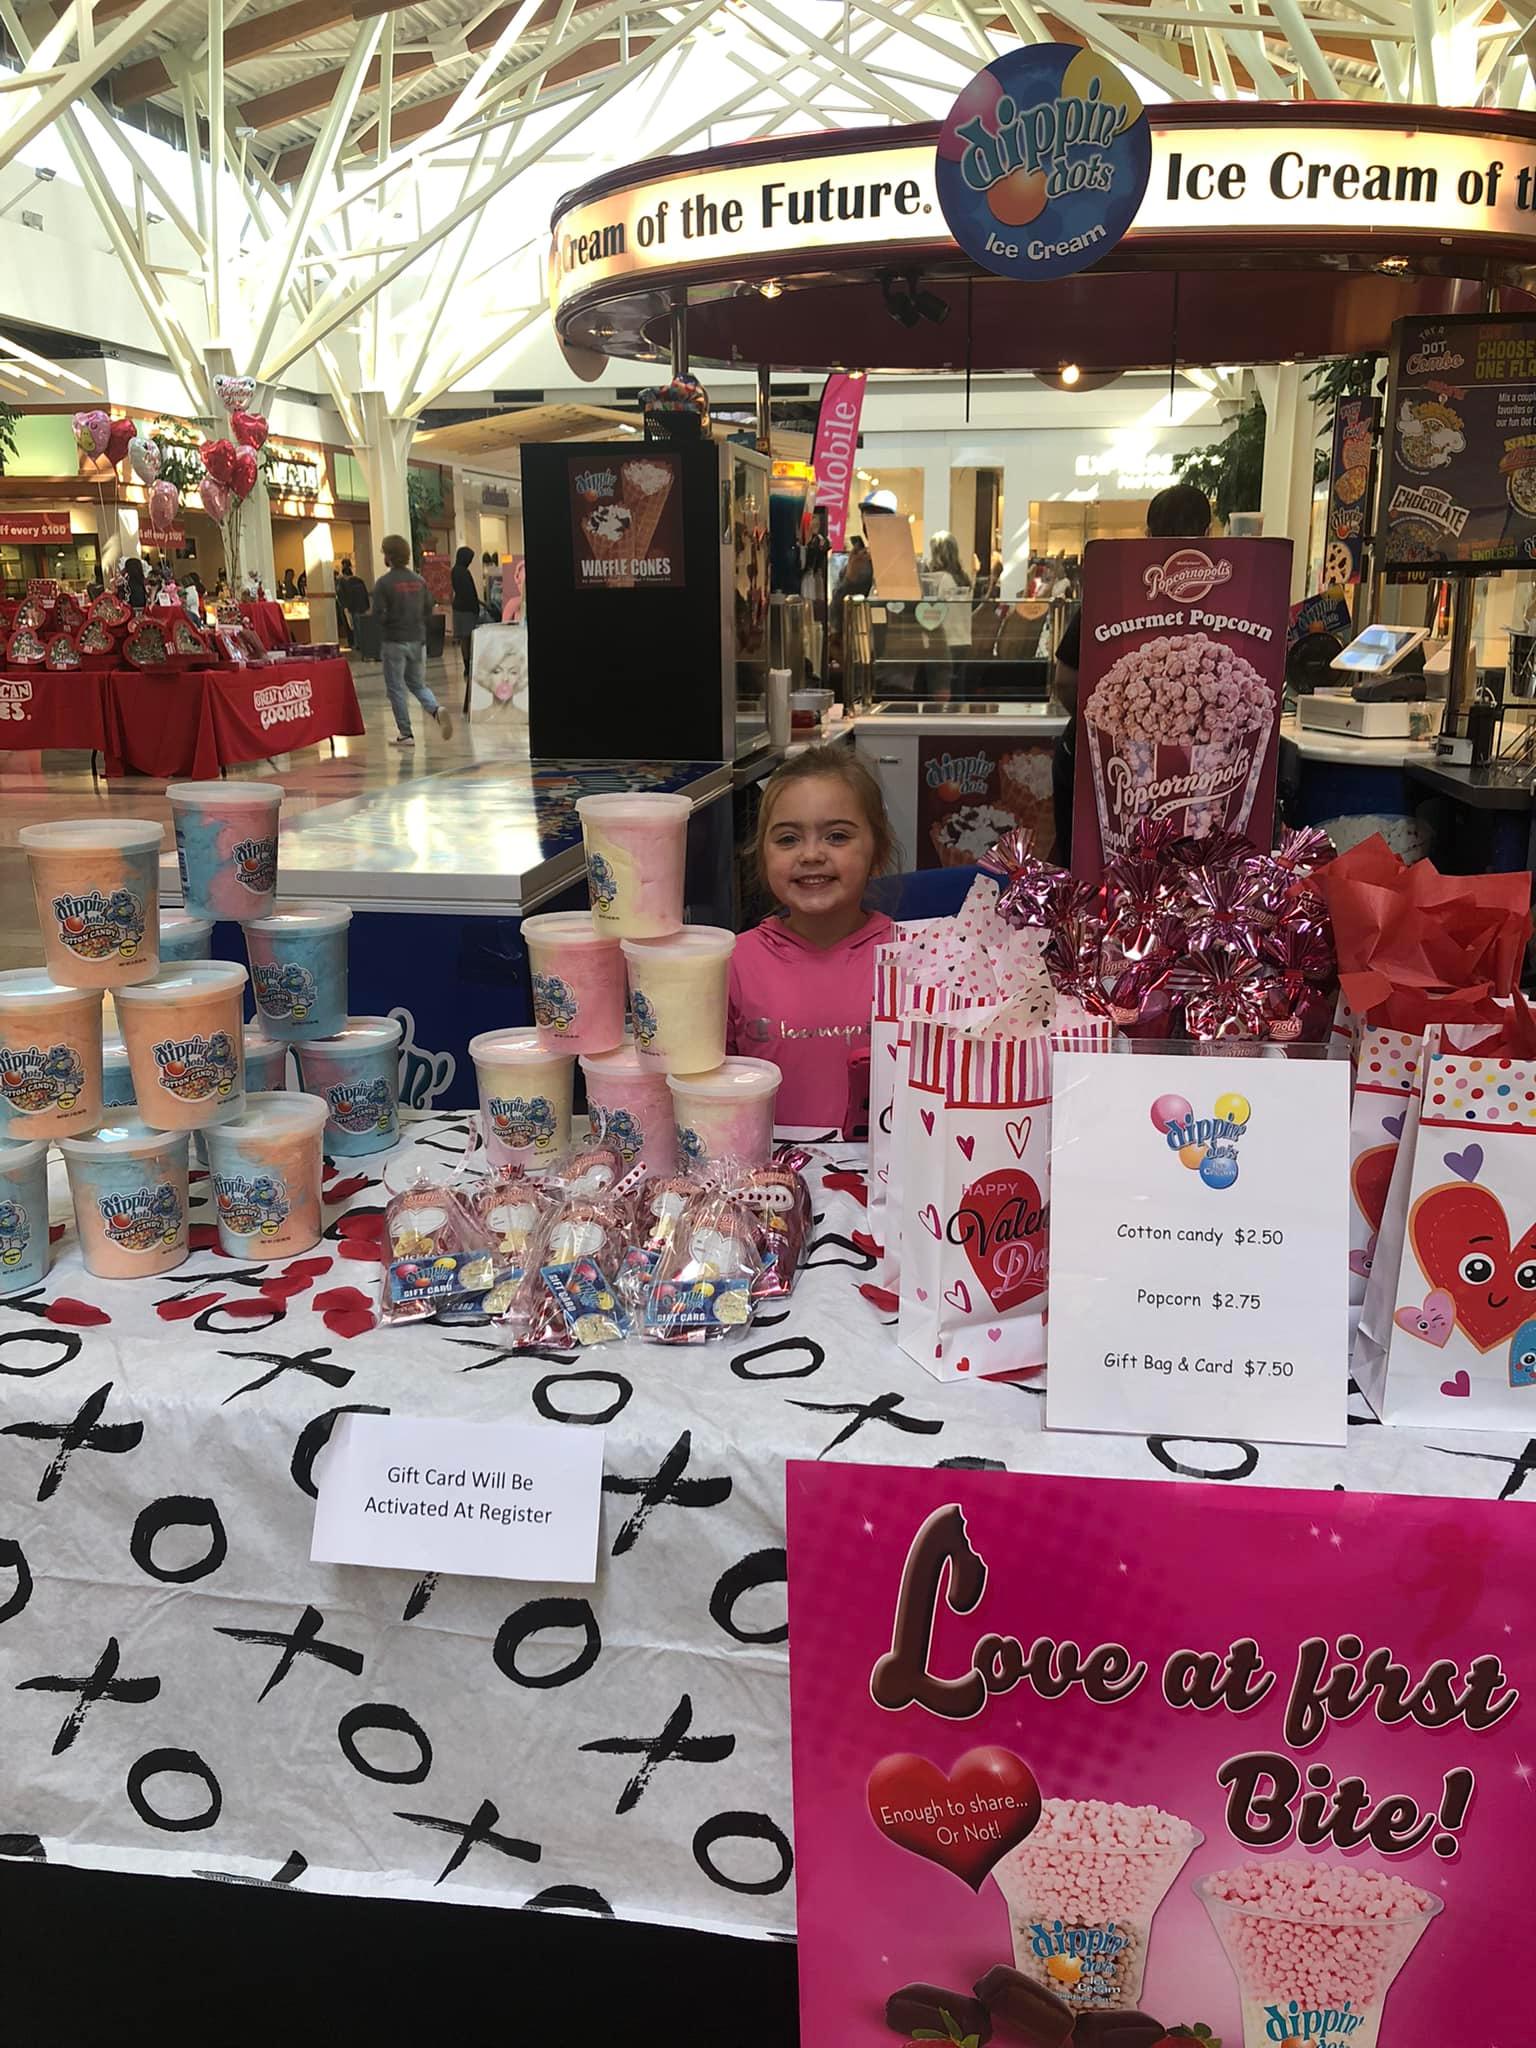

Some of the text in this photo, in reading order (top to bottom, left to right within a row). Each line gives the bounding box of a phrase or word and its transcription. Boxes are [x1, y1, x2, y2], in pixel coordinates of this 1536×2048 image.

[955, 77, 1128, 191] dippin'
[1045, 155, 1115, 199] dots
[1166, 152, 1246, 201] Ice
[1268, 151, 1439, 202] Cream
[1457, 160, 1504, 207] of
[637, 201, 669, 248] of
[681, 193, 744, 240] the
[984, 224, 1107, 260] Ice Cream
[1422, 341, 1448, 355] DOT
[1477, 340, 1536, 360] CHOOSE
[1406, 351, 1465, 375] Combo
[1475, 360, 1506, 379] ONE
[1392, 489, 1467, 534] CHOCOLATE
[10, 525, 39, 538] every
[42, 524, 67, 536] $100
[581, 557, 672, 577] WAFFLE CONES
[1143, 559, 1233, 599] Popcornopolis
[1094, 609, 1273, 643] Gourmet Popcorn
[925, 750, 995, 788] dippin'
[1107, 748, 1252, 816] Popcornopolis
[54, 892, 109, 919] dippin'
[83, 913, 105, 926] dots
[60, 928, 117, 945] COTTON CANDY
[153, 1035, 210, 1065] dippin'
[21, 1069, 43, 1080] dots
[184, 1057, 206, 1069] dots
[28, 1080, 57, 1093] CANDY
[159, 1069, 218, 1089] COTTON CANDY
[1164, 1112, 1247, 1152] dippin'
[1206, 1142, 1239, 1161] dots
[962, 1183, 1018, 1197] HAPPY
[101, 1186, 155, 1220] dippin'
[105, 1221, 161, 1241] COTTON CANDY
[1116, 1224, 1284, 1247] Cotton candy $2.50
[404, 1284, 453, 1298] GIFT CARD
[1136, 1289, 1261, 1311] Popcorn $2.75
[680, 1313, 706, 1322] CARD
[1104, 1353, 1294, 1378] Gift Bag & Card $7.50
[387, 1466, 534, 1491] Gift Card Will Be
[364, 1496, 553, 1526] Activated At Register
[870, 1502, 1519, 1749] Love at first
[879, 1793, 1029, 1826] Enough to share...
[1216, 1750, 1475, 1858] Bite!
[936, 1820, 1002, 1846] Or Not!
[1029, 1919, 1131, 1959] dippin'
[1080, 1956, 1117, 1975] dots
[1076, 1981, 1122, 1995] Cream
[1089, 1976, 1109, 1986] Ice
[1264, 2000, 1366, 2042] dippin'
